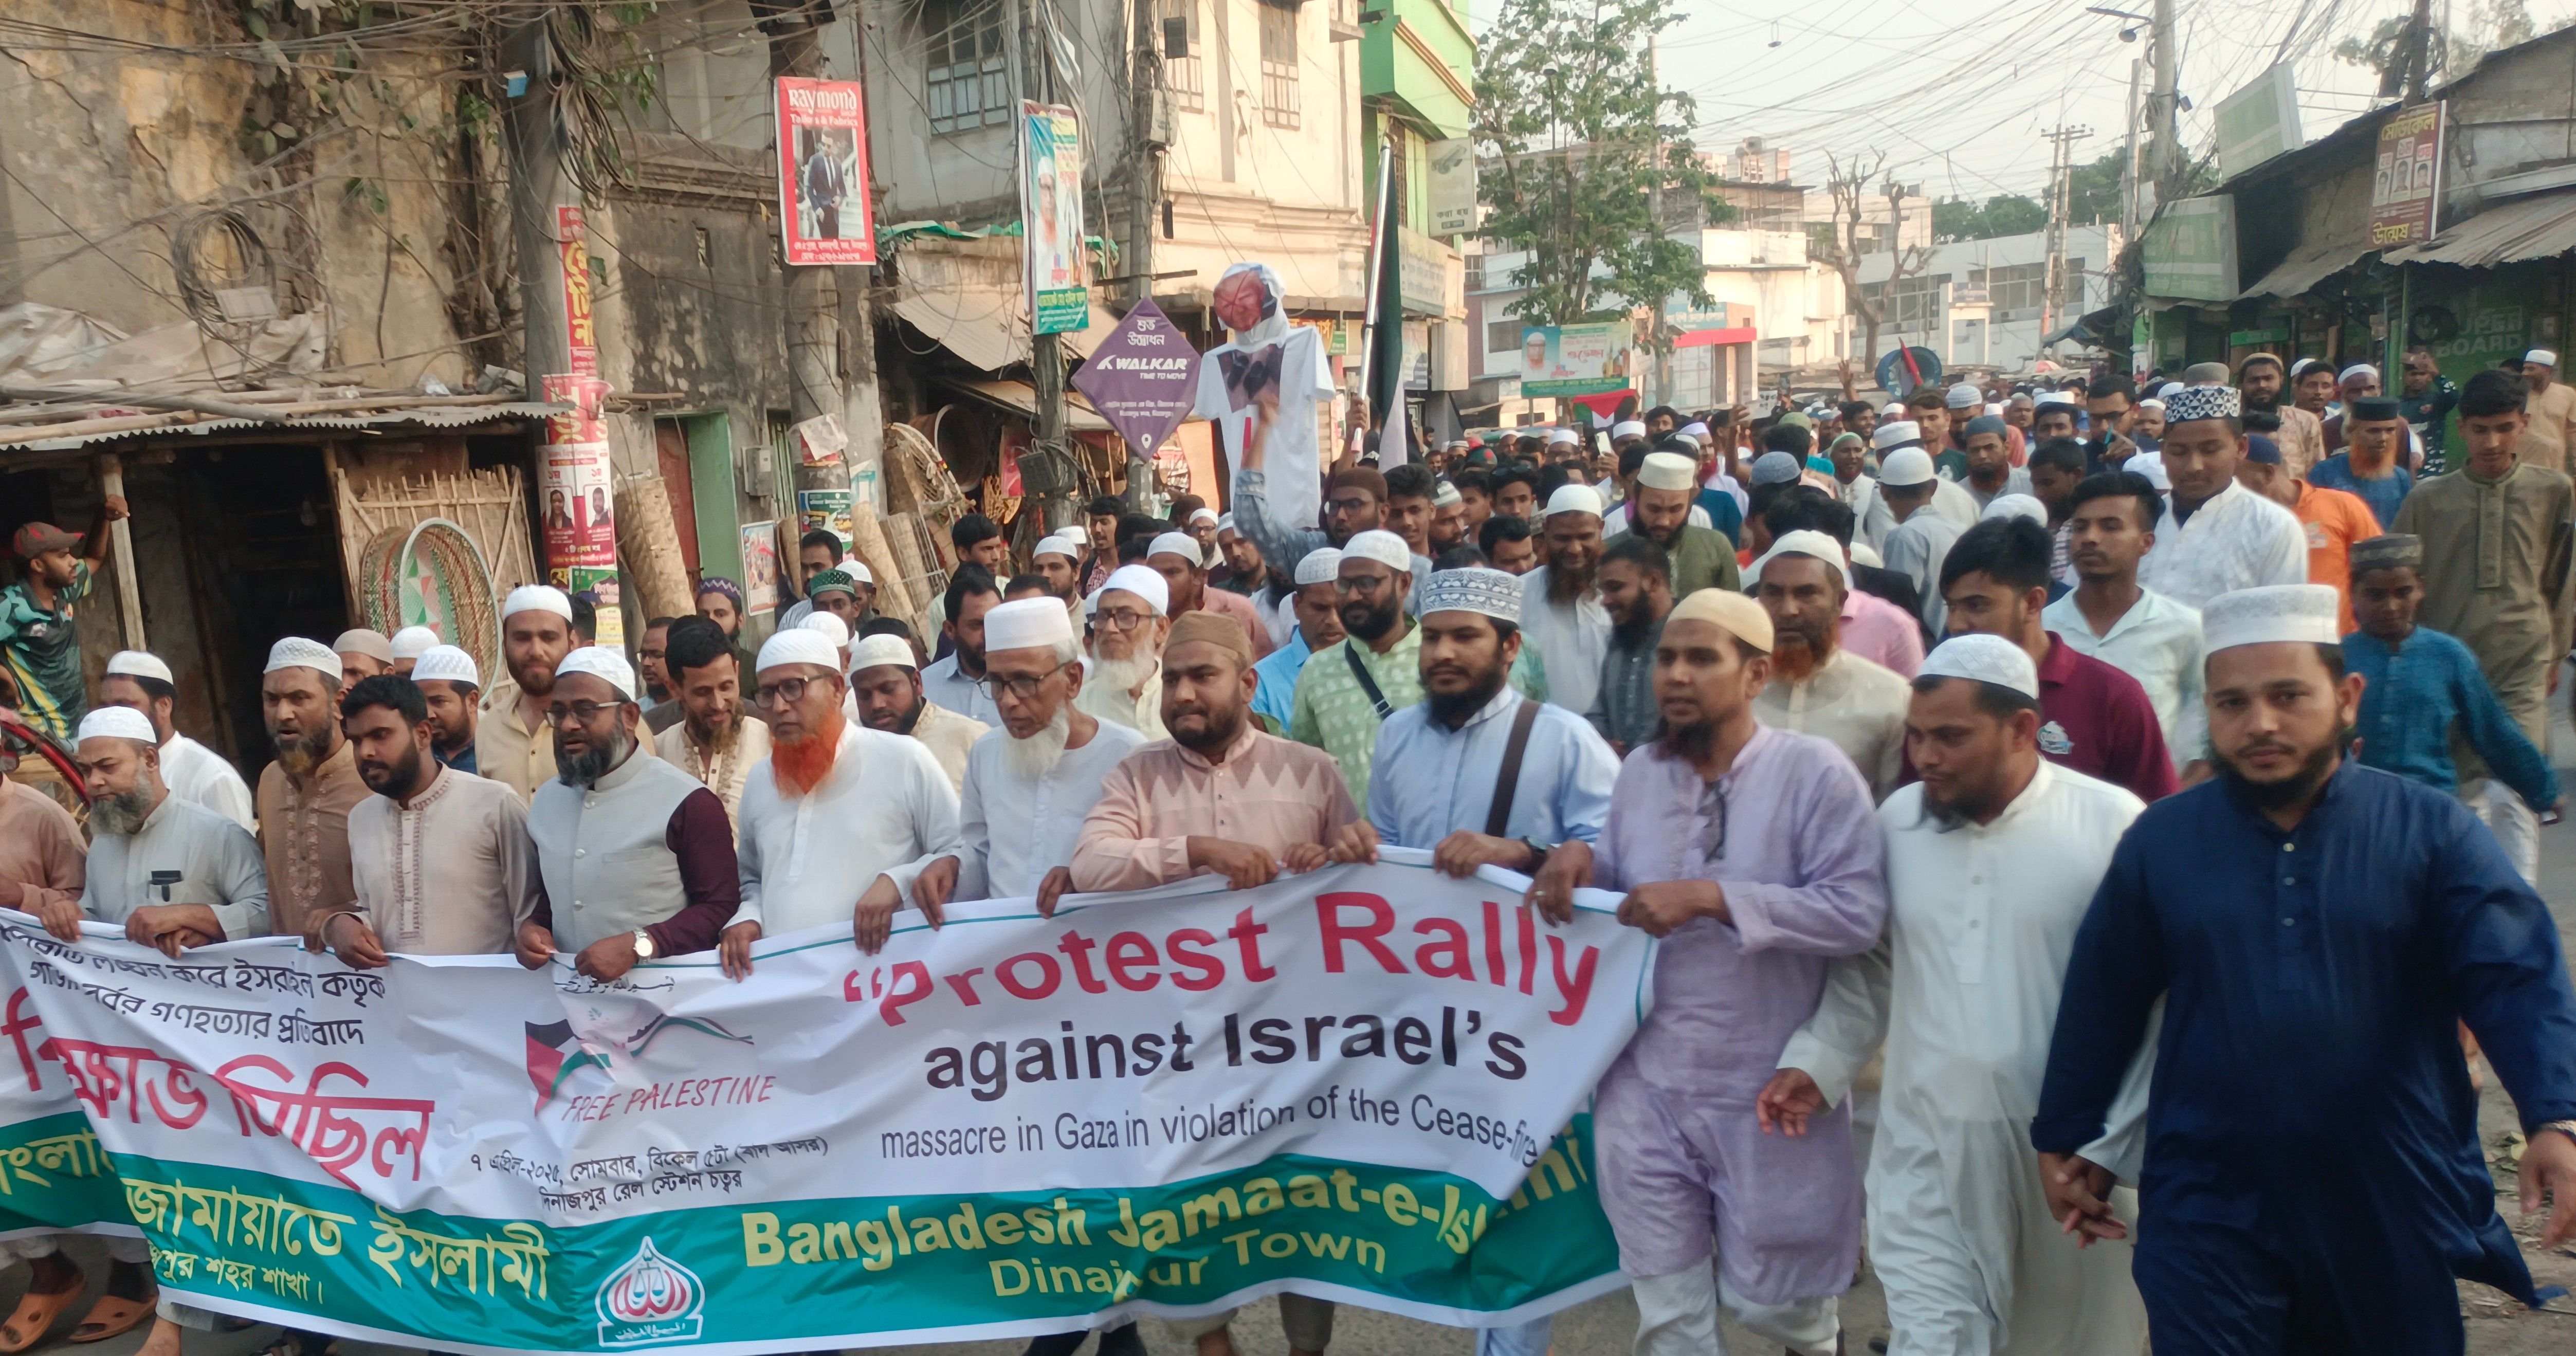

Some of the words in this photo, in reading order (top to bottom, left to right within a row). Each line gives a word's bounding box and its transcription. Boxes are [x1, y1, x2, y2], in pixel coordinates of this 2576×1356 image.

[789, 88, 857, 114] Raymond
[1137, 319, 1156, 331] শুভ
[2434, 334, 2522, 358] BOARD
[1116, 358, 1187, 370] WALKAR
[166, 964, 228, 988] করে
[1314, 891, 1600, 1026] Rally
[151, 1002, 272, 1039] গণহত্যার
[278, 1007, 363, 1046] প্রতিবাদে
[924, 1020, 1195, 1102] against
[561, 1093, 617, 1122] FREE
[624, 1075, 777, 1115] PALESTINE
[882, 1125, 1007, 1159] massacre
[1018, 1116, 1044, 1152] in
[1055, 1112, 1120, 1151] Gaza
[1125, 1110, 1149, 1147] in
[1160, 1098, 1295, 1145] violation
[1307, 1085, 1340, 1120] of
[1348, 1089, 1399, 1125] the
[471, 1154, 482, 1172] ৭
[570, 1154, 643, 1181] সোমবার,
[647, 1146, 699, 1171] বিকেল
[613, 1181, 644, 1202] রেল
[652, 1170, 704, 1195] স্টেশন
[742, 1197, 1092, 1272] Bangladesh
[1108, 1121, 1588, 1254] Jamaat-e-Islmi
[121, 1177, 356, 1257] জামায়াতে
[367, 1201, 550, 1302] ইসলামী
[1222, 1228, 1386, 1275] Town
[205, 1256, 257, 1292] শহর
[261, 1267, 312, 1302] শাখা
